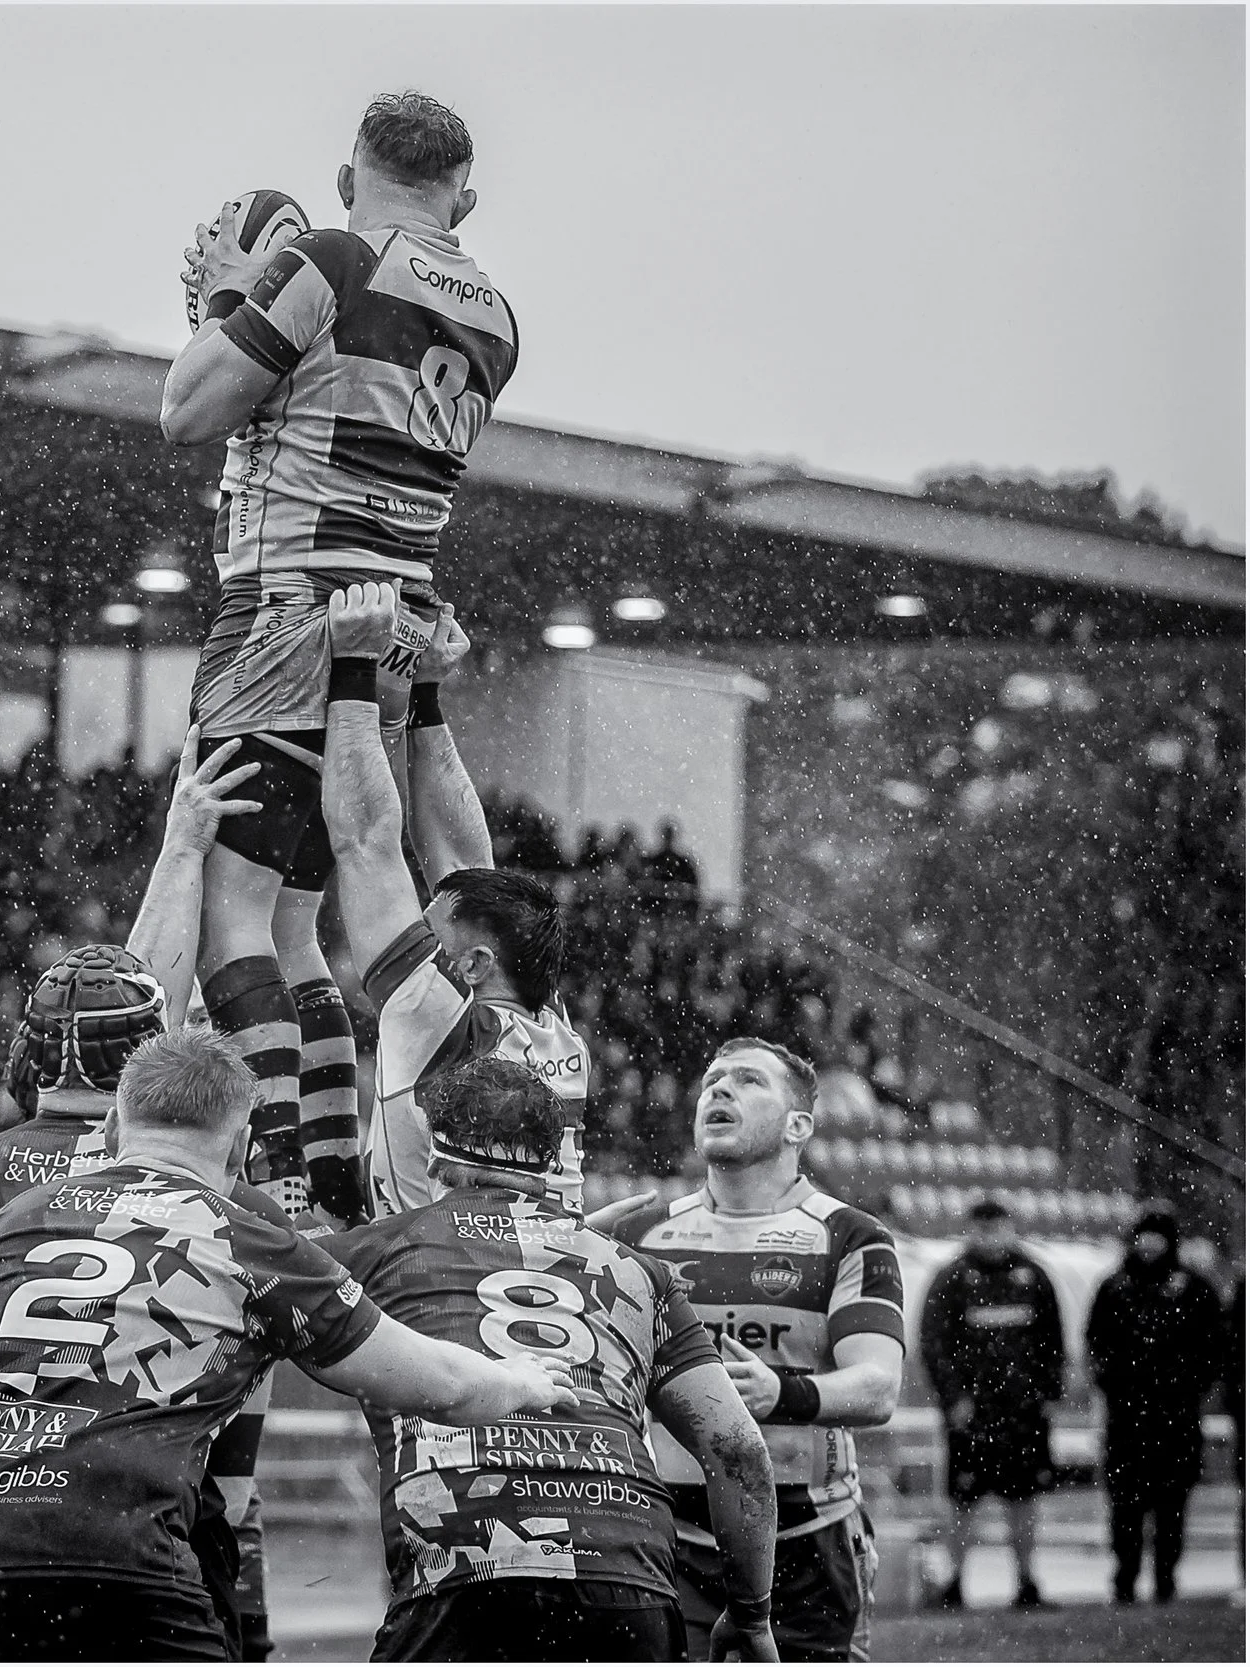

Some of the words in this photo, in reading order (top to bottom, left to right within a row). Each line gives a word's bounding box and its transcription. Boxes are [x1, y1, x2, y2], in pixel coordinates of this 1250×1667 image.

[409, 257, 493, 308] Compra
[408, 345, 470, 452] 8
[8, 1146, 108, 1168] Herbert
[56, 1184, 157, 1200] Herbert
[452, 1211, 548, 1229] Herbert
[476, 1269, 596, 1367] 8
[44, 1411, 68, 1434] &
[483, 1425, 581, 1453] PENNY
[589, 1431, 612, 1454] &
[511, 1475, 652, 1510] shawgibbs
